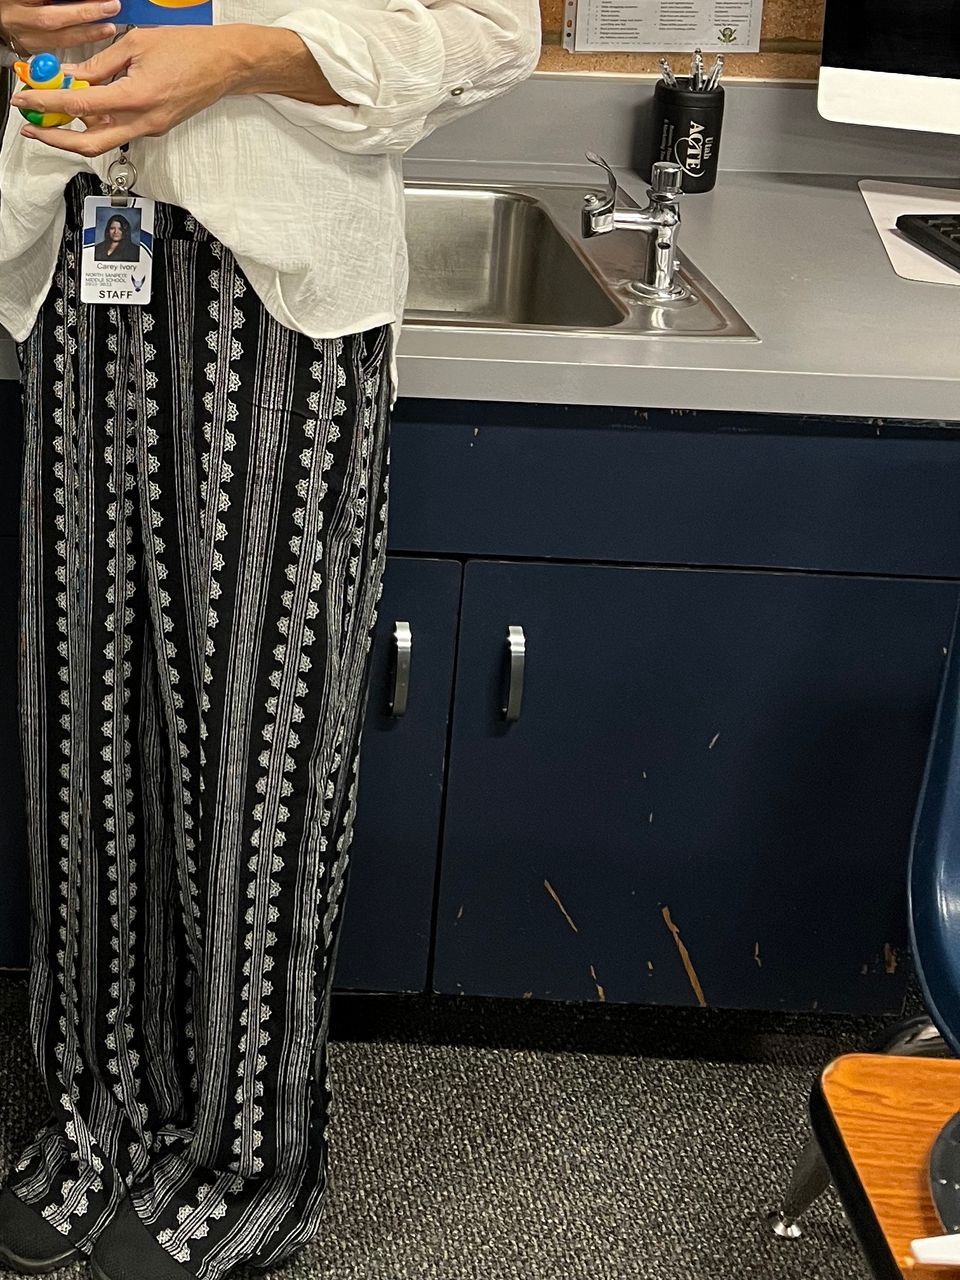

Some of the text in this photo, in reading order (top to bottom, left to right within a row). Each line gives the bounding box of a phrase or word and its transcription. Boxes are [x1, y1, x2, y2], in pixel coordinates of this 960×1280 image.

[686, 120, 705, 170] ACTE
[704, 137, 713, 160] Utah
[99, 290, 133, 299] STAFF
